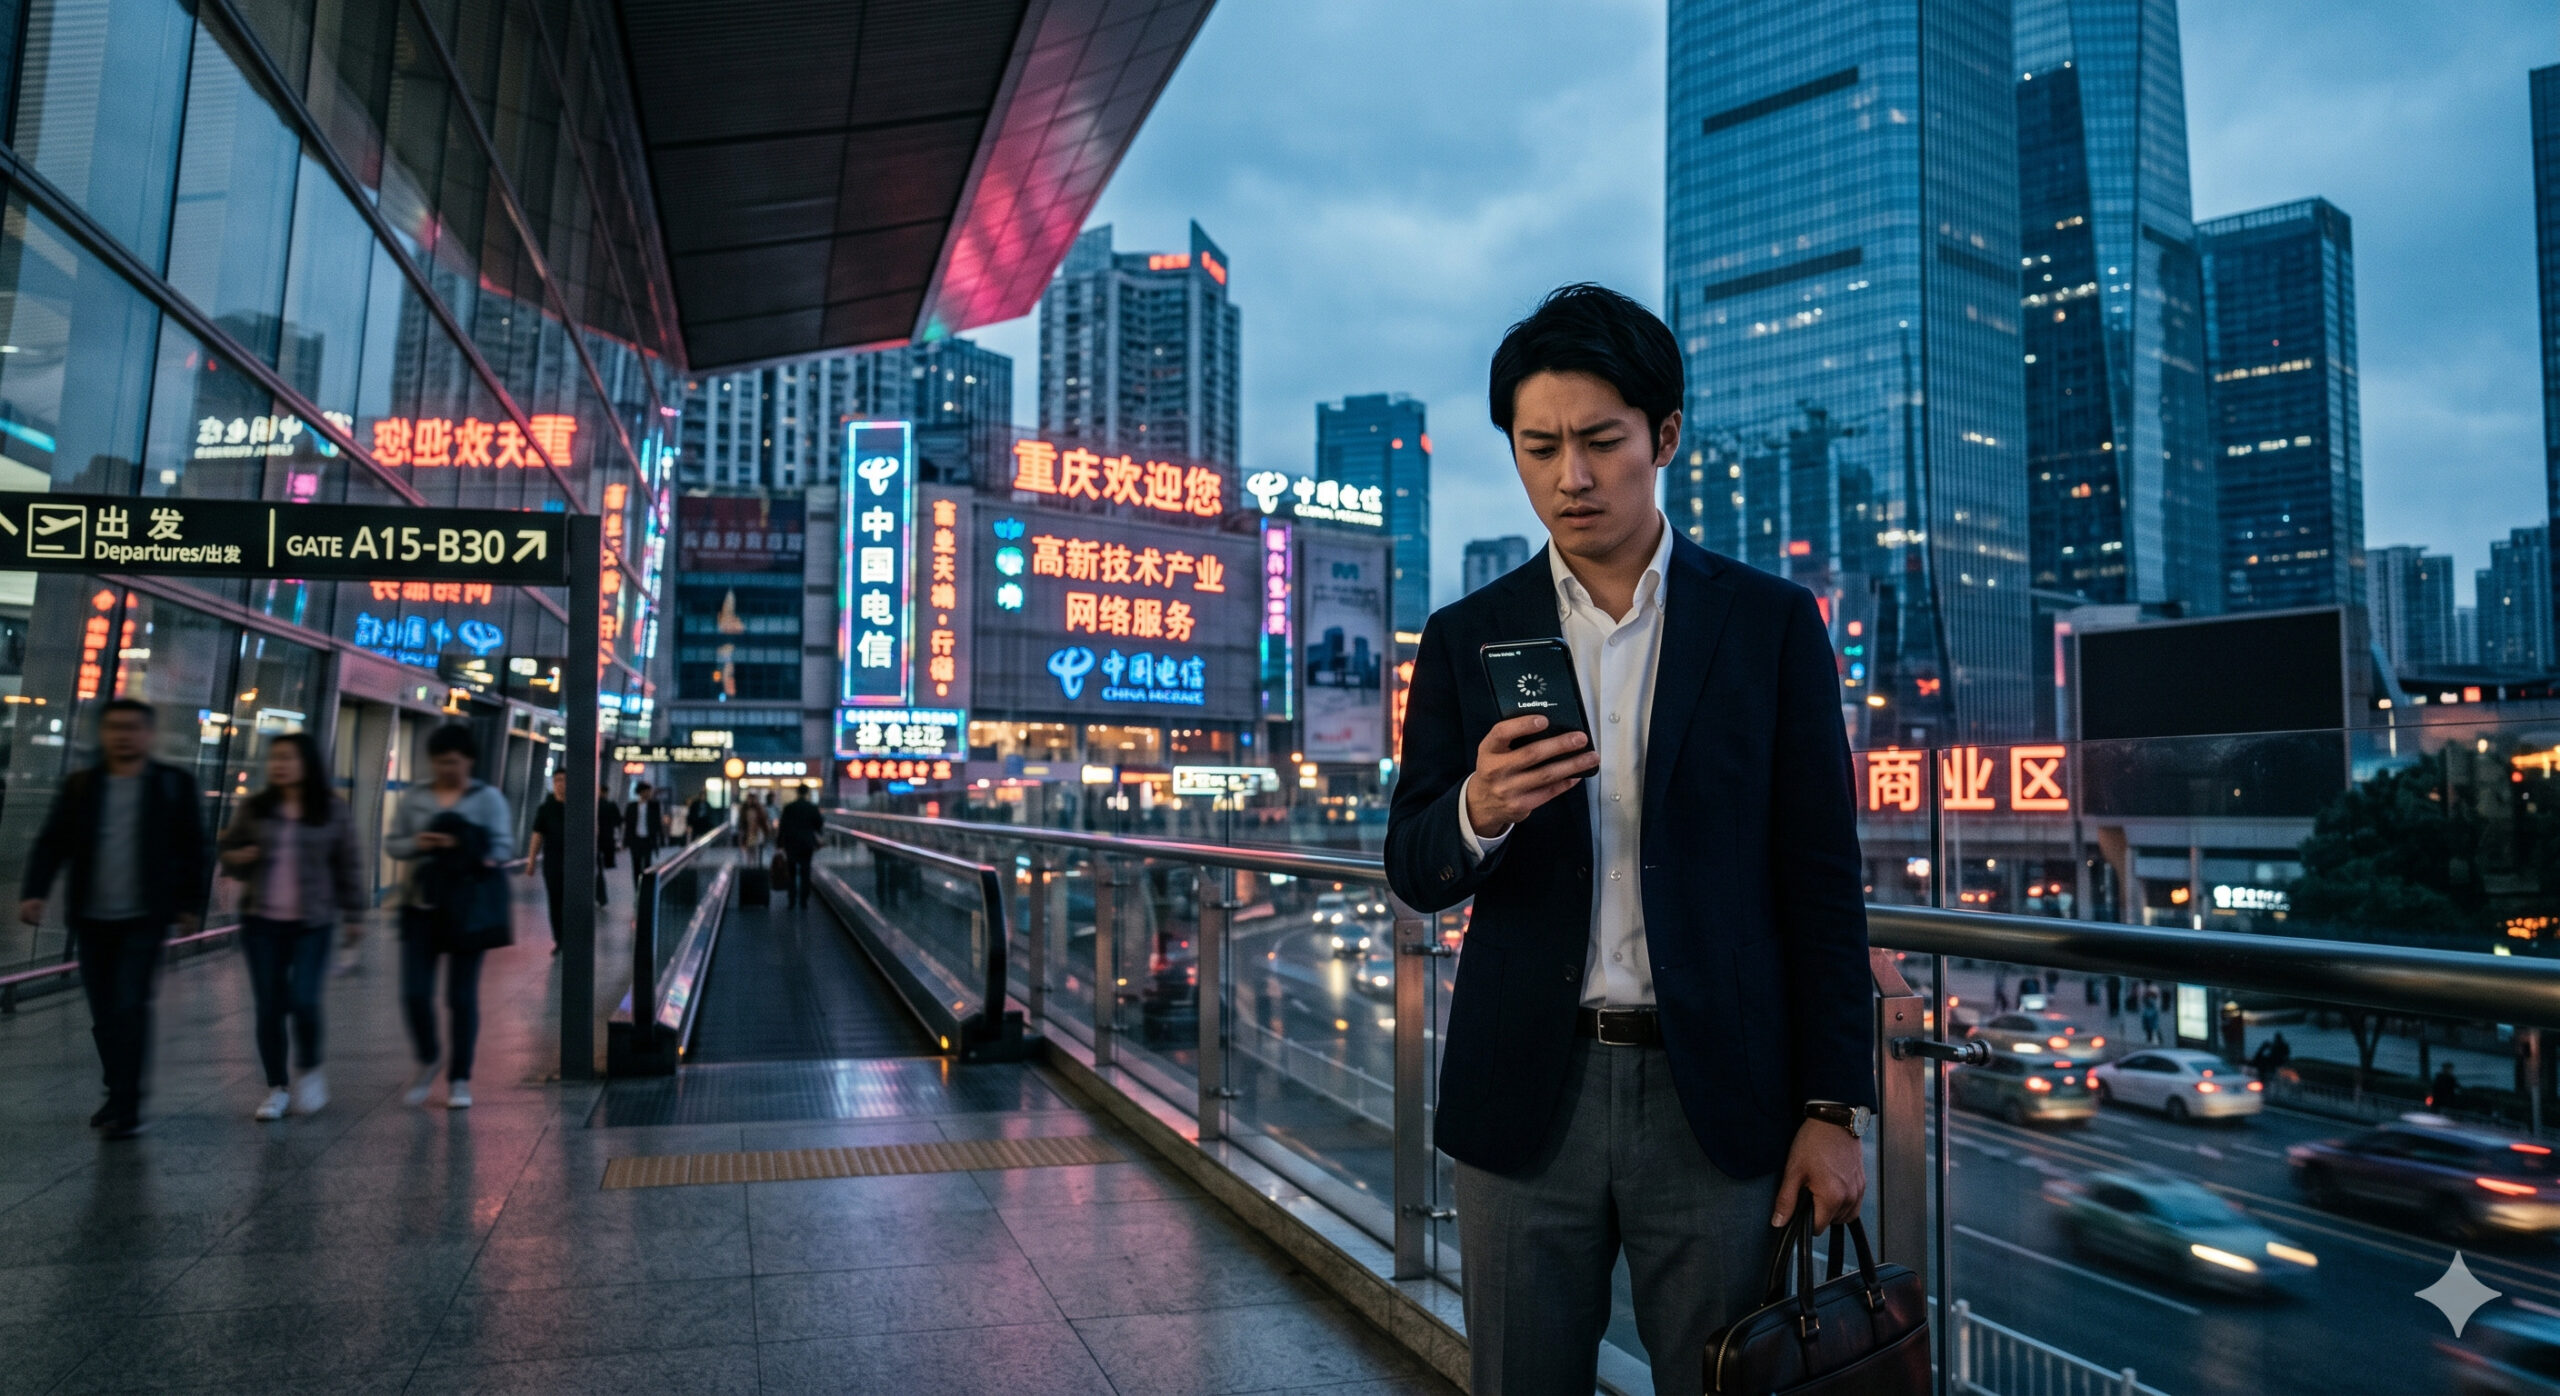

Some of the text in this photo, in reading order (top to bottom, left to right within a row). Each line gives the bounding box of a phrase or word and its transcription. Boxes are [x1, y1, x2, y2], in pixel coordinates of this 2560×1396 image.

[1013, 439, 1223, 517] 重庆欢迎您
[286, 525, 506, 565] GATE A15-B30
[1031, 534, 1226, 593] 高新技术产业
[857, 505, 895, 668] 中国电信
[1066, 591, 1195, 642] 网络服务
[1867, 745, 2069, 812] 商业区
